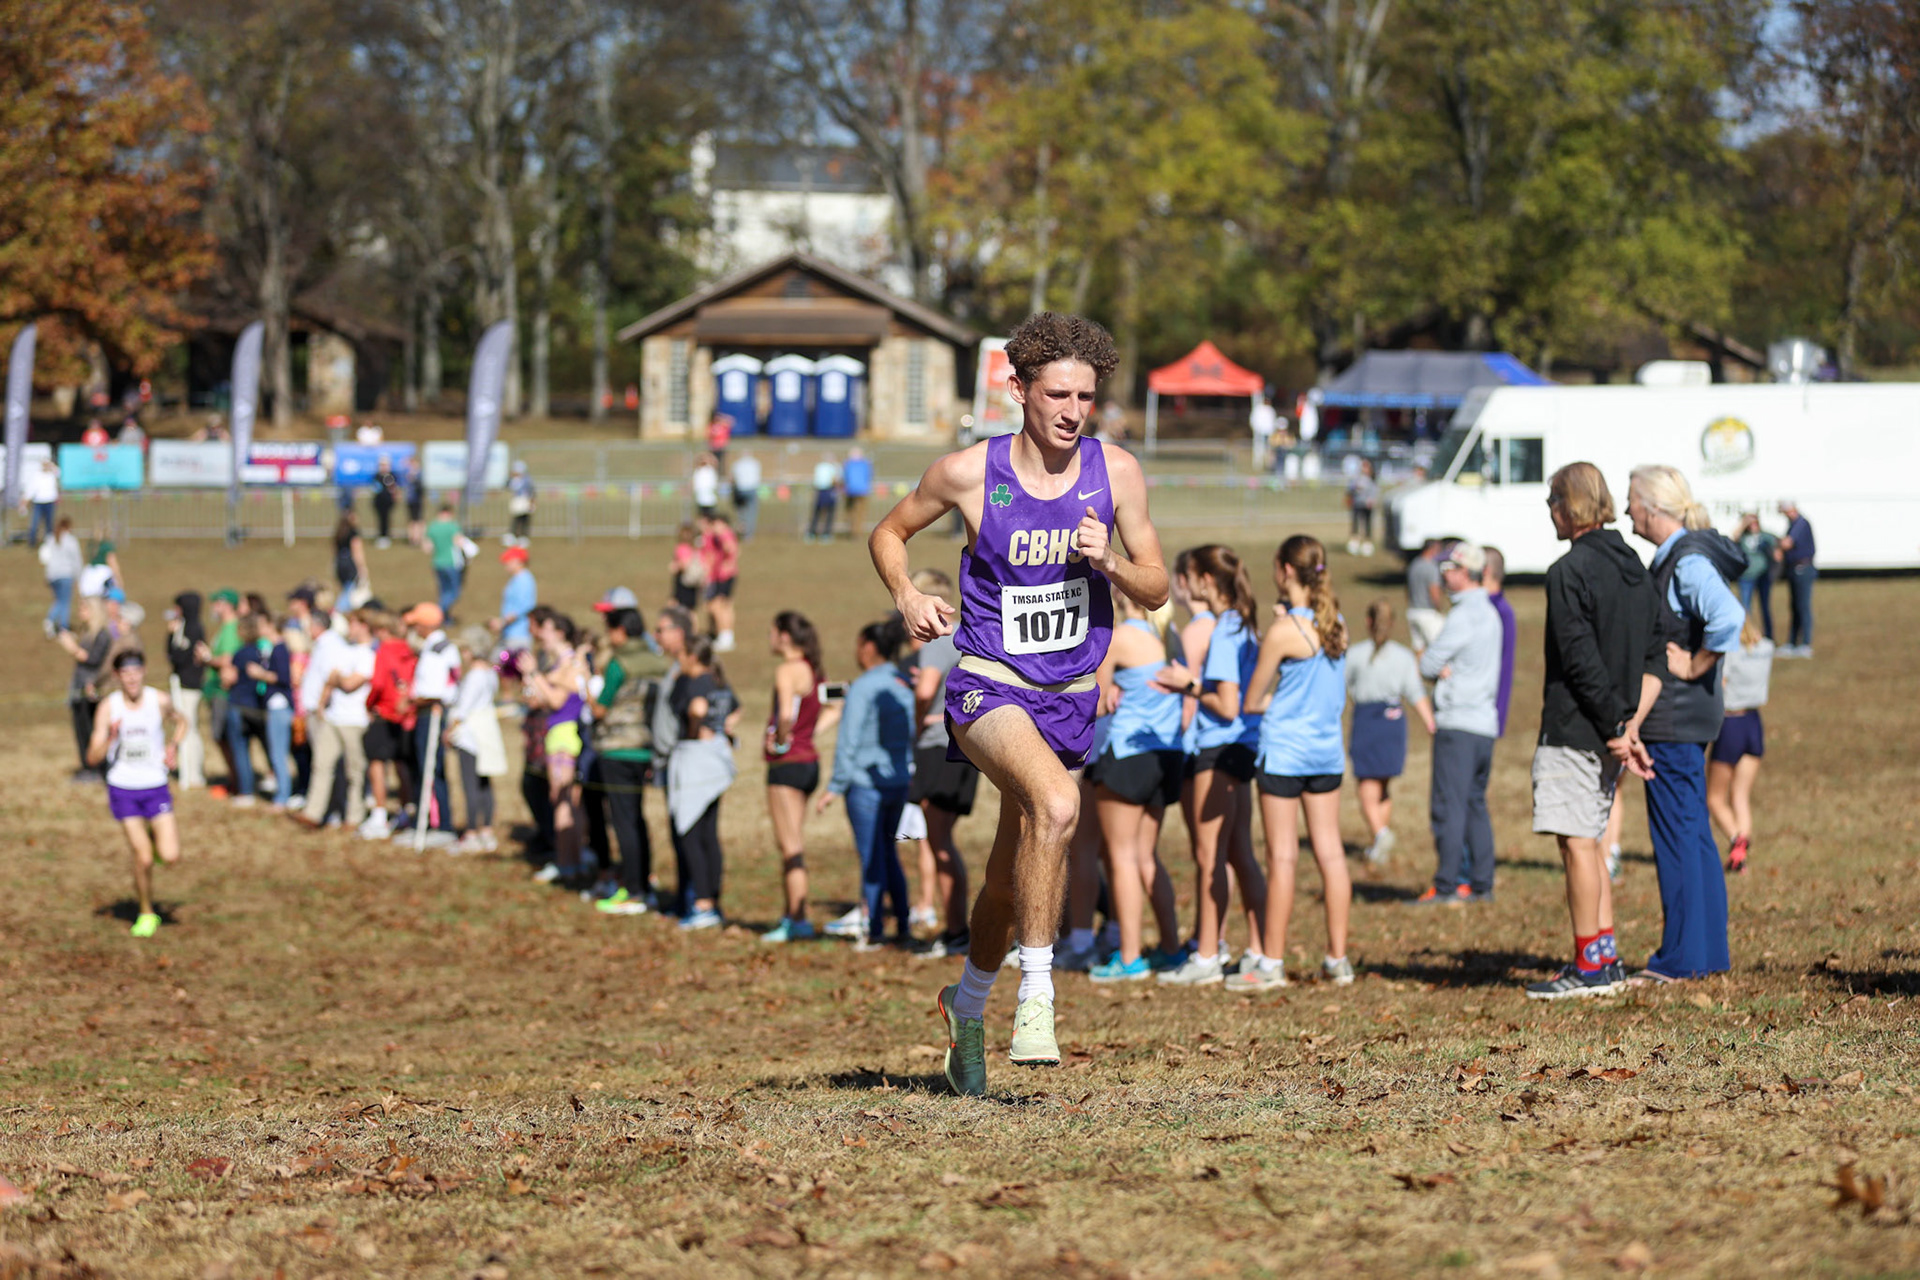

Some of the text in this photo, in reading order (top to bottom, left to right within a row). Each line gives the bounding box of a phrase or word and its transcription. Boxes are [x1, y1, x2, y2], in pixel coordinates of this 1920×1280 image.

[1012, 587, 1082, 605] TMSAA STATE XC
[1013, 605, 1080, 643] 1077
